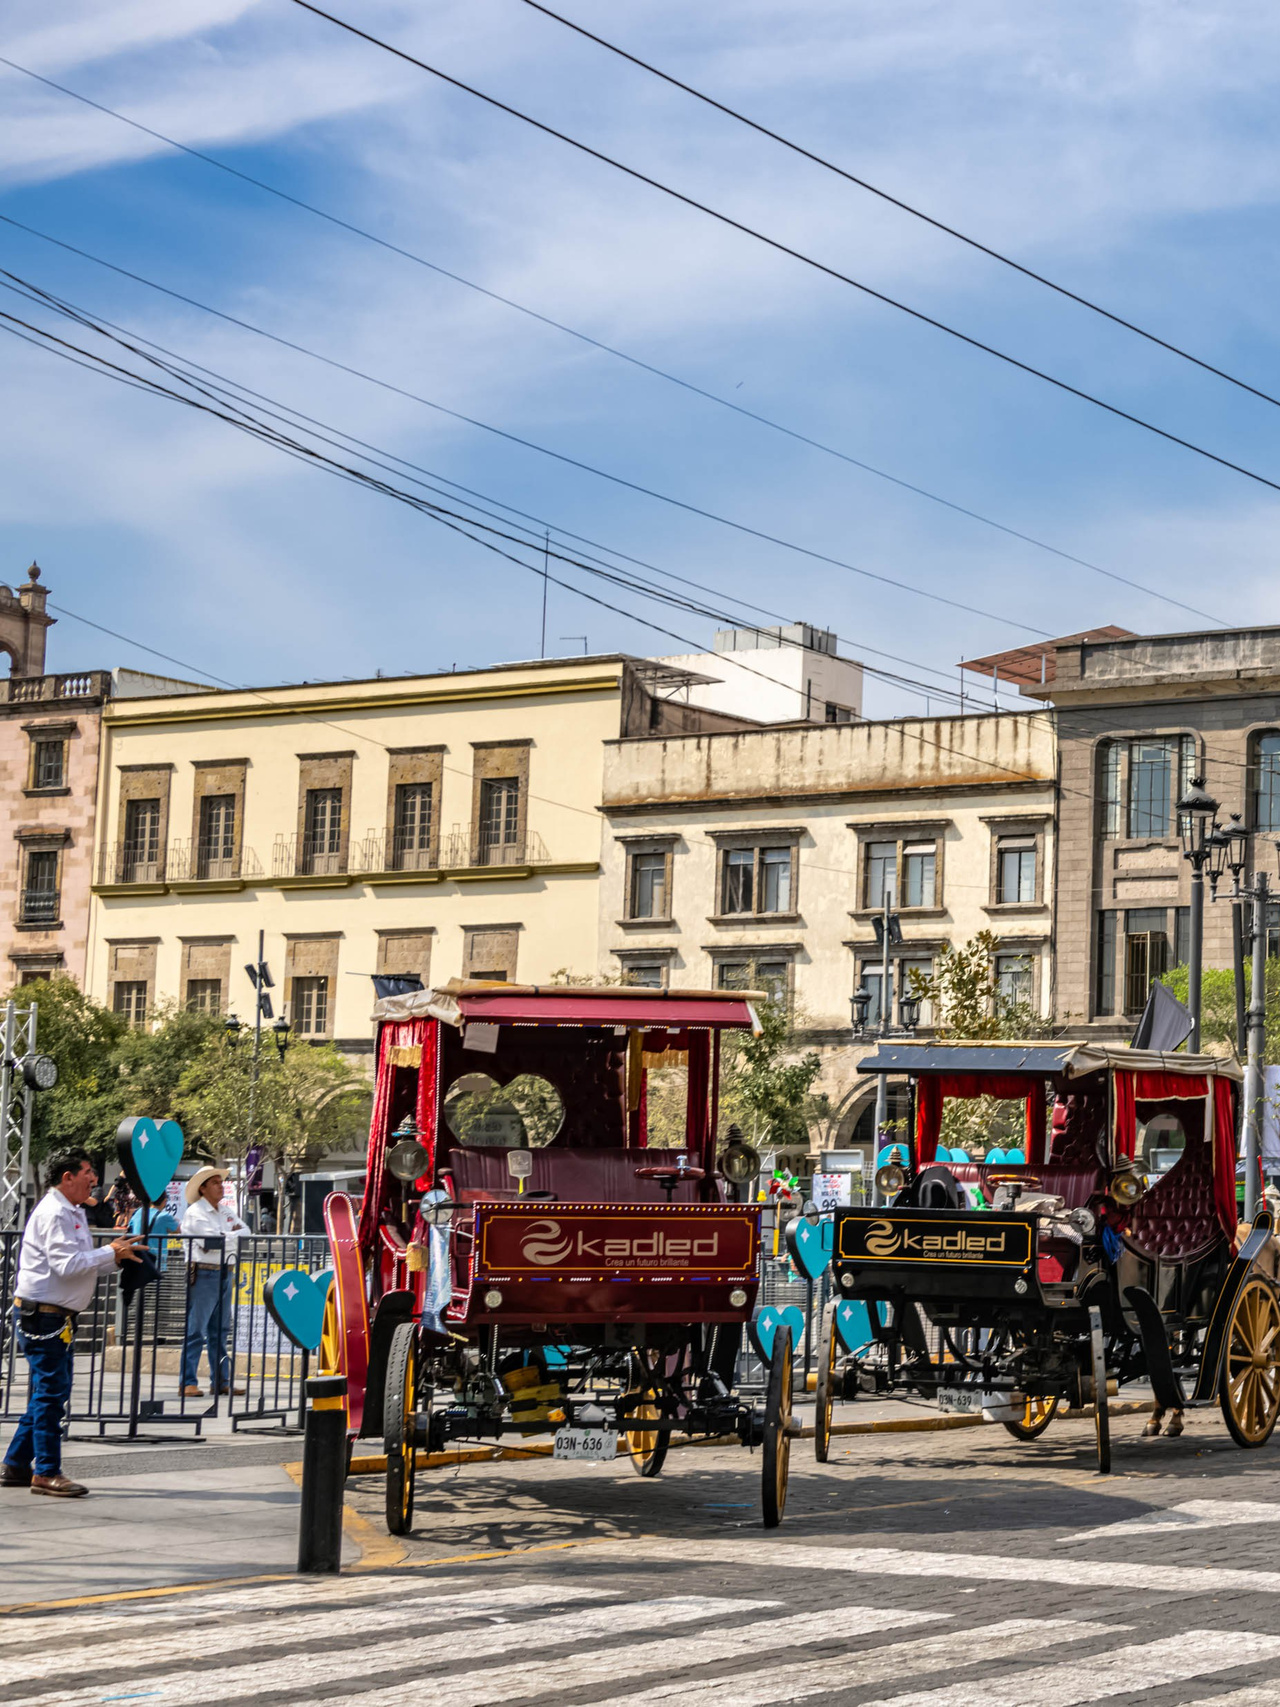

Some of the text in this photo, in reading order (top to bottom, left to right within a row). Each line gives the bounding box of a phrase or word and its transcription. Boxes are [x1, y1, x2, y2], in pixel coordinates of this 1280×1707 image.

[577, 1230, 719, 1257] kadled
[903, 1228, 1006, 1252] kadled
[923, 1250, 937, 1258] Crea
[945, 1250, 962, 1259] futuro
[605, 1257, 690, 1267] Crea un futuro brillante
[938, 1394, 972, 1406] 03N-639
[556, 1436, 603, 1451] 03N-636
